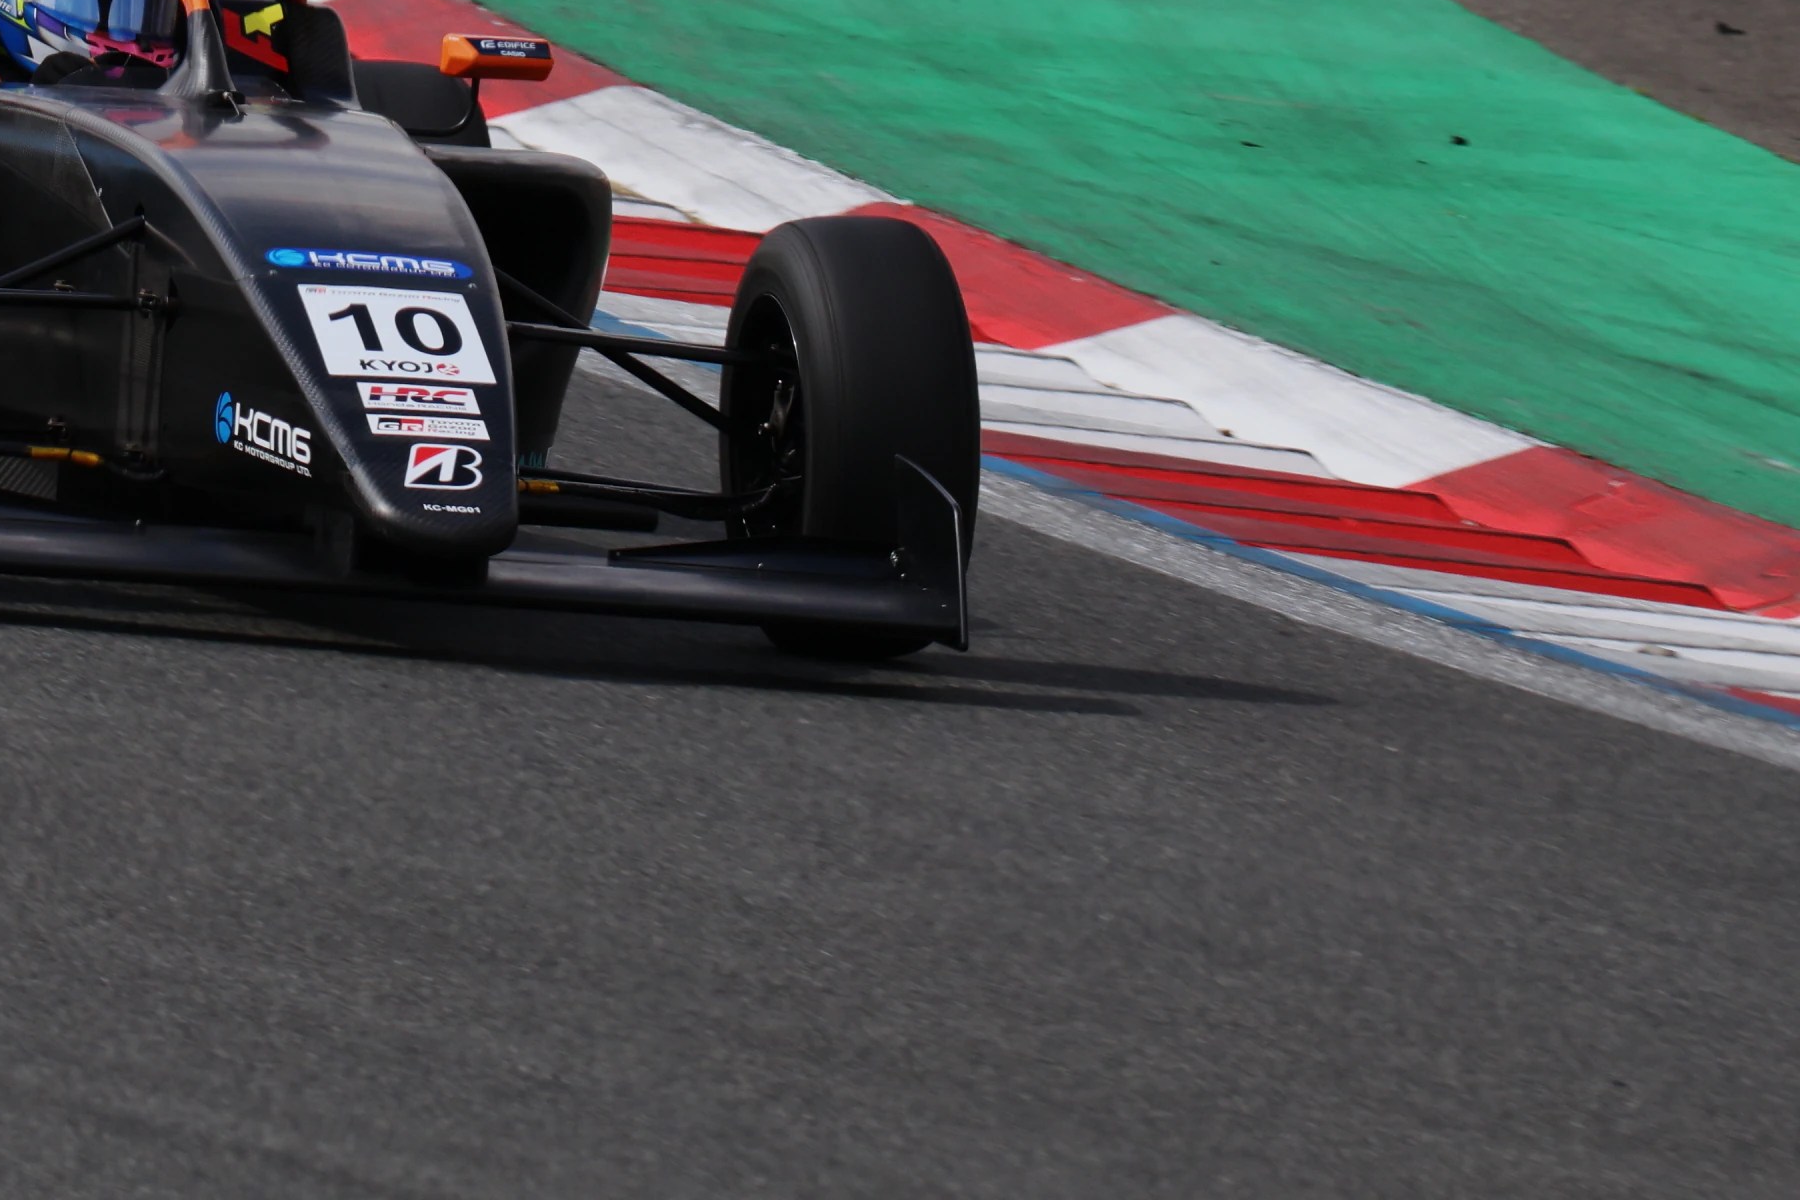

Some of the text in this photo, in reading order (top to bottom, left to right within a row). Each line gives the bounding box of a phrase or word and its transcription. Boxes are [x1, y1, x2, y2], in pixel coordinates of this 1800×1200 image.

[497, 41, 536, 49] EDIFICE
[500, 50, 526, 58] CASIO
[309, 251, 455, 274] KCMG
[328, 303, 463, 356] 10
[369, 386, 468, 407] HRC
[234, 402, 311, 464] KCMG
[377, 417, 424, 432] GR
[233, 440, 243, 451] KC
[244, 444, 295, 471] MOTORGROUP
[423, 503, 481, 514] KC-MG01
